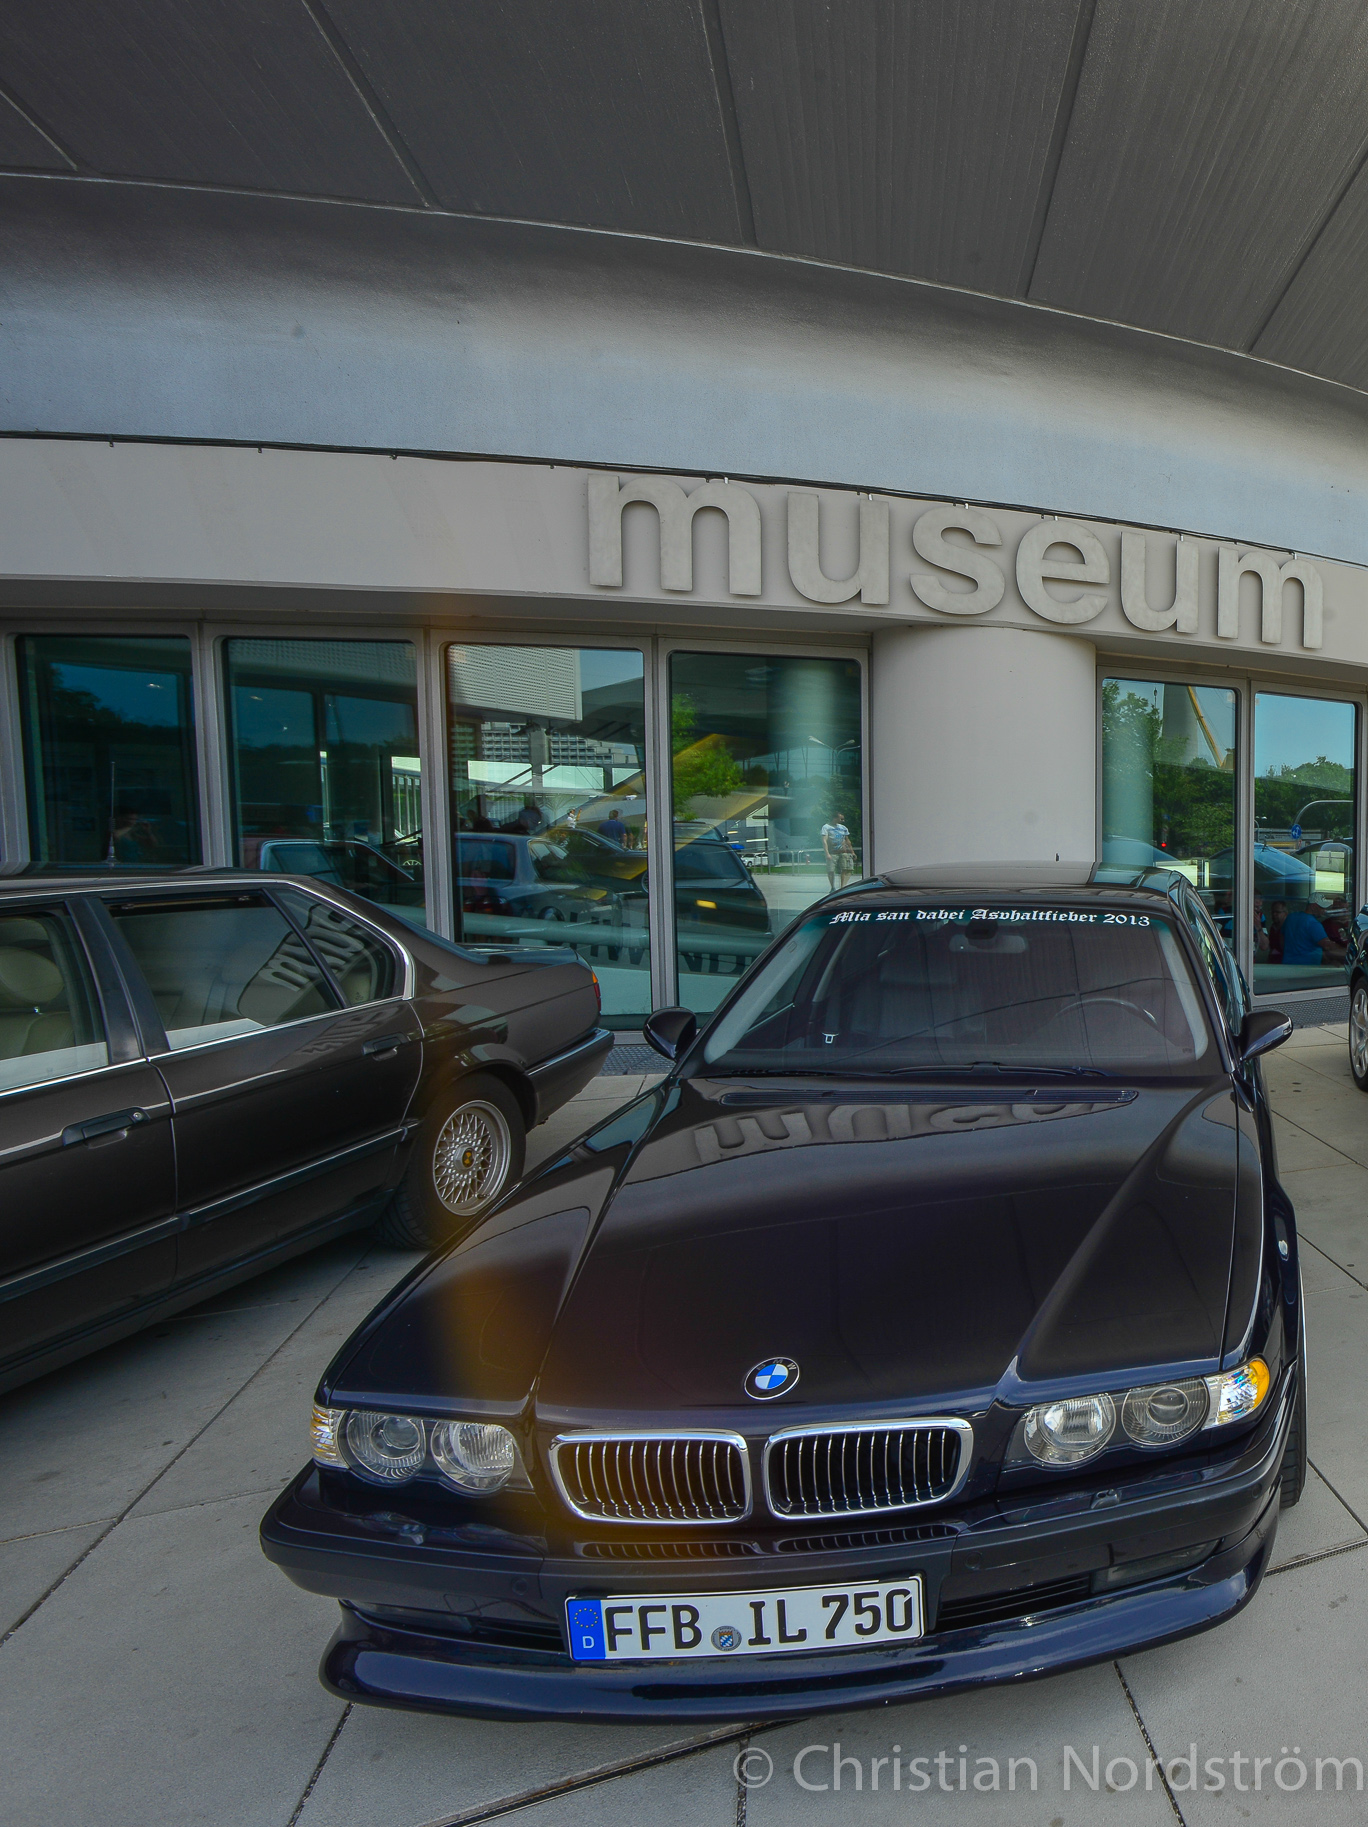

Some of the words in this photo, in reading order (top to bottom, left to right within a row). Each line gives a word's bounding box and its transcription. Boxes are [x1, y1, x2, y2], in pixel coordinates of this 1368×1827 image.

[587, 473, 1324, 649] museum
[875, 911, 910, 921] san
[916, 909, 965, 920] dabei
[1103, 913, 1150, 926] 2013
[604, 1603, 703, 1652] FFB
[748, 1598, 807, 1647] IL
[821, 1587, 913, 1640] 750
[582, 1635, 595, 1649] D
